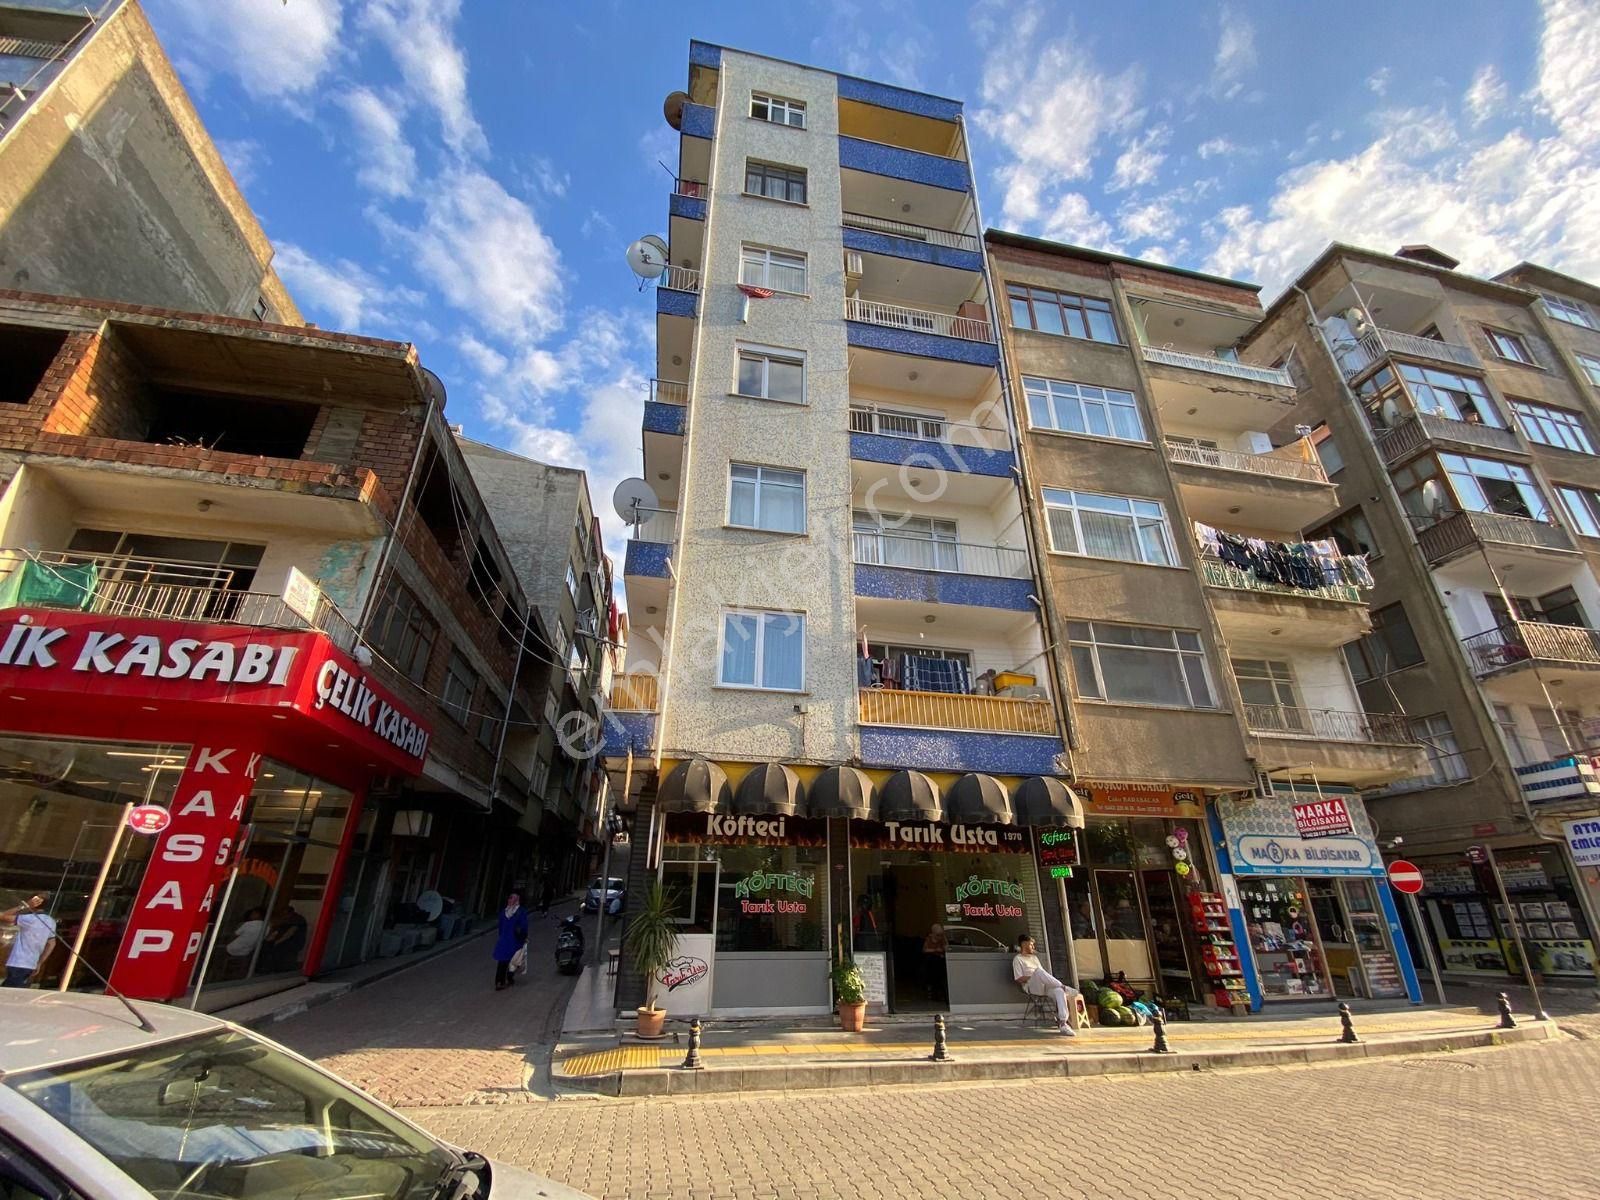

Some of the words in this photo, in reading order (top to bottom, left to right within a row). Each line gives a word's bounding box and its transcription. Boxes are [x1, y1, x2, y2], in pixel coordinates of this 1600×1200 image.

[73, 631, 299, 687] KASABI
[316, 660, 374, 727] ÇELİK
[374, 705, 430, 761] KASABI
[1294, 801, 1345, 820] MARKA
[1297, 814, 1348, 828] BİLGİSAYAR
[706, 815, 785, 838] Köfteci
[885, 821, 943, 844] Tarık
[950, 824, 998, 846] Usta
[1003, 832, 1022, 842] 1970
[128, 747, 238, 960] KASAP
[183, 751, 261, 962] KASAP
[1251, 842, 1300, 862] MARKA
[1306, 846, 1362, 862] BİLGİSAYAR
[741, 899, 774, 914] Tarık
[777, 900, 807, 914] Usta
[963, 903, 993, 917] Tarık
[995, 905, 1023, 917] Usta
